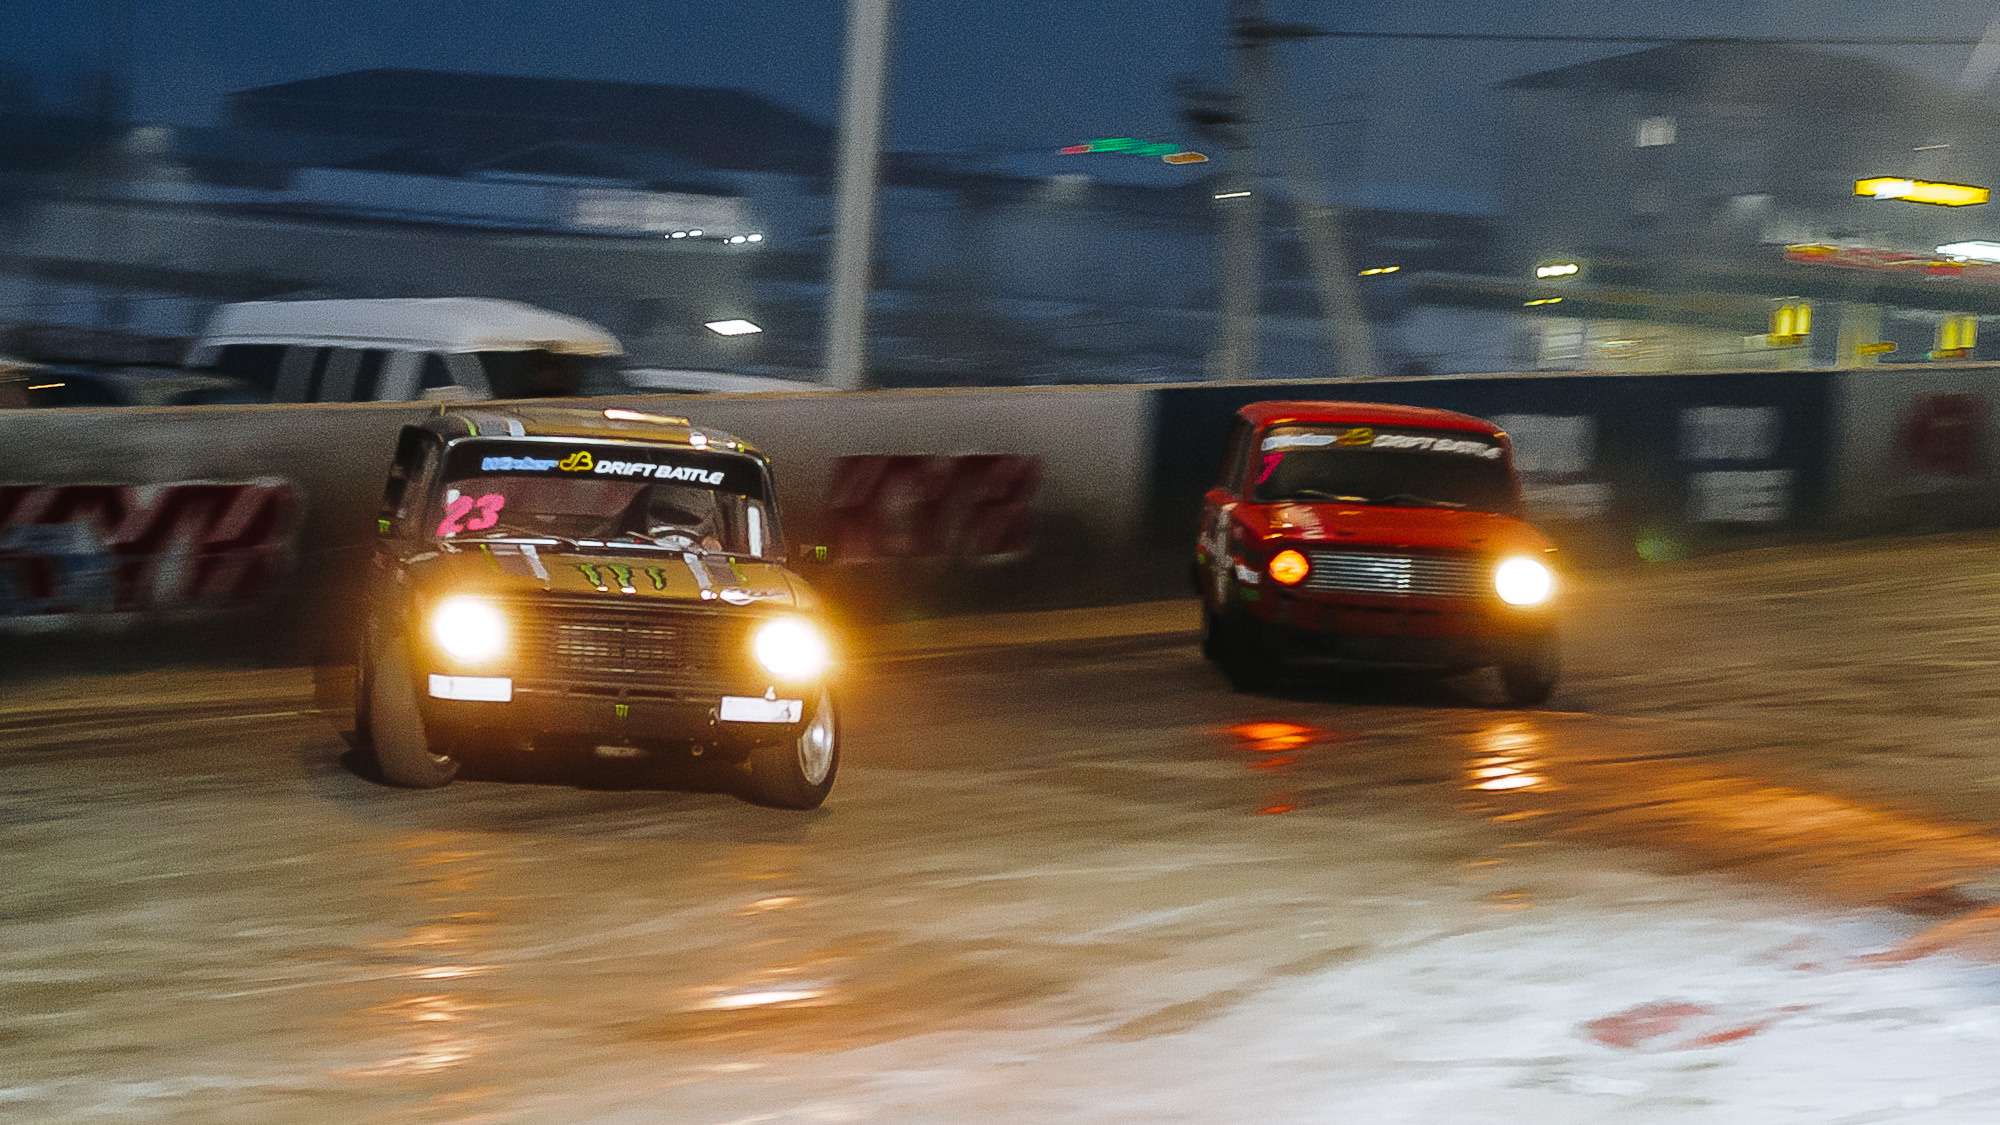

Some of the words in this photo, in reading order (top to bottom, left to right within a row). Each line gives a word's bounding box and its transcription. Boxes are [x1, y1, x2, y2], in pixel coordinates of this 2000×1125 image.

[594, 460, 657, 477] DRIFT
[654, 465, 725, 485] BATTLE
[436, 493, 505, 537] 23
